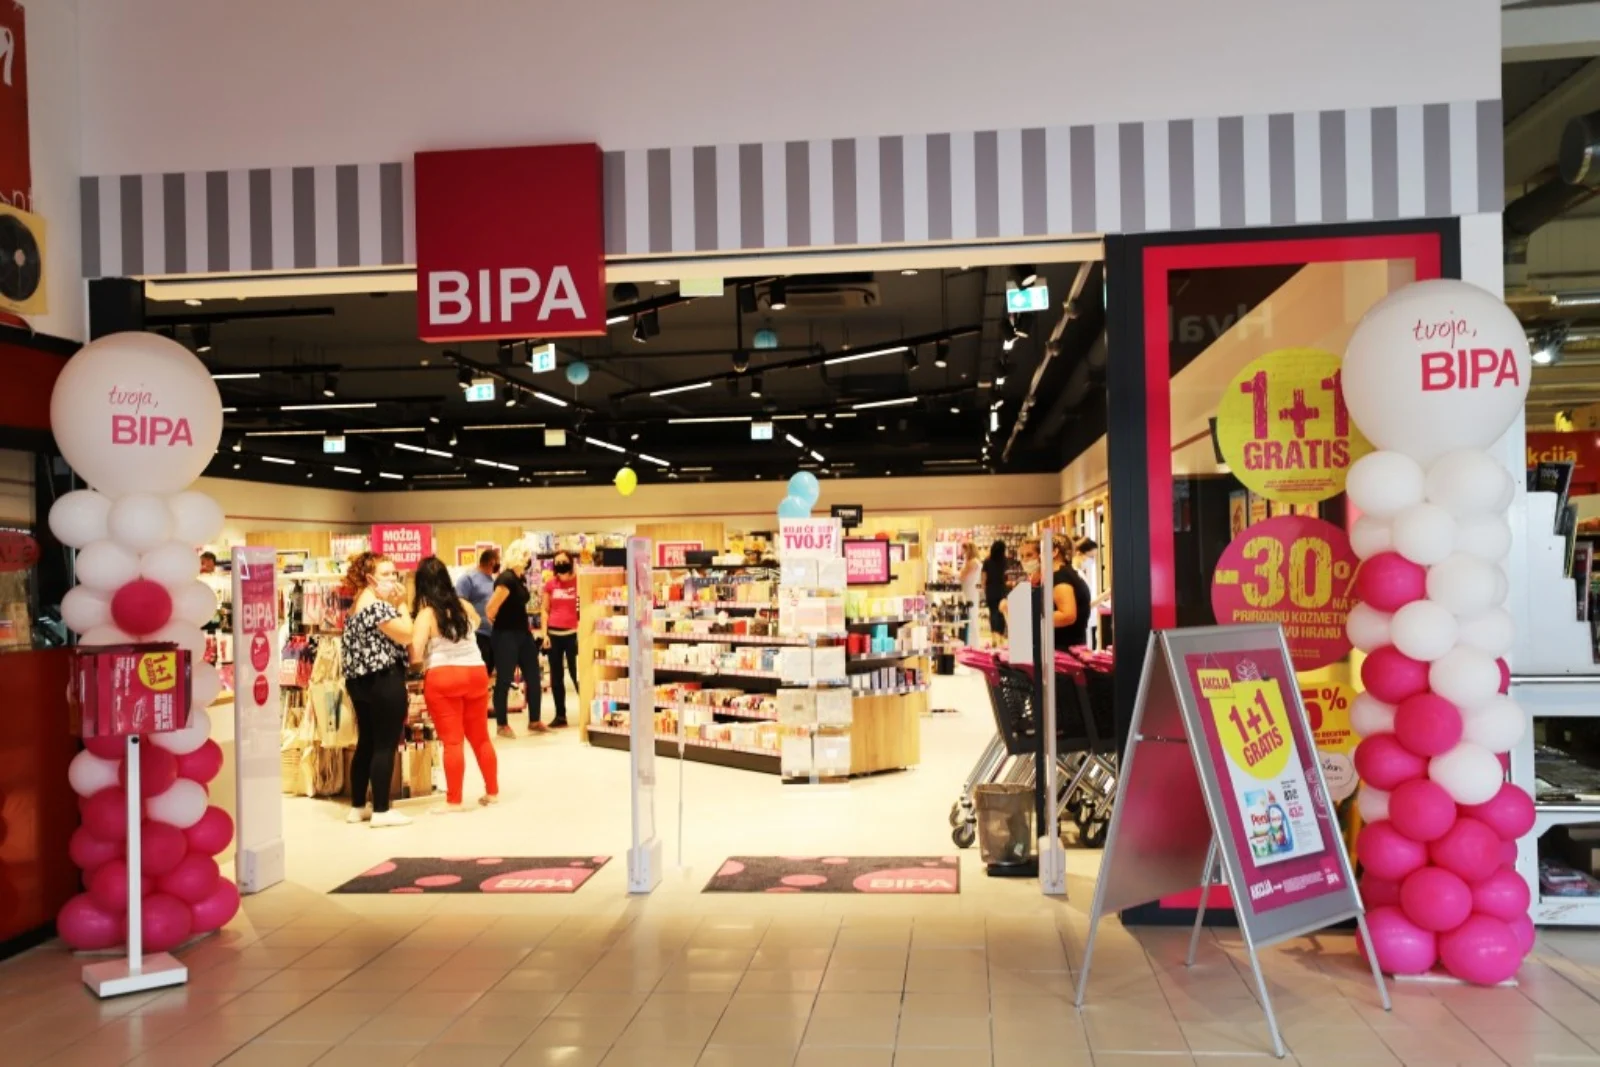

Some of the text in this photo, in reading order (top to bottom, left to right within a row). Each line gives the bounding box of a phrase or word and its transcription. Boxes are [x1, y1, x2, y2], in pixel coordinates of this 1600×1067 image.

[428, 265, 587, 326] BIPA
[1412, 310, 1478, 349] tvoja,
[1421, 348, 1520, 391] BIPA
[108, 383, 159, 415] tvoja,
[1240, 368, 1350, 439] 1+1
[112, 415, 193, 447] BIPA
[1243, 439, 1351, 470] GRATIS
[382, 528, 421, 541] MOŽDA
[783, 534, 833, 549] TVOJ?
[243, 602, 274, 629] BIPA
[1232, 609, 1349, 625] PRIRODNU KOZMETIK
[1332, 597, 1348, 610] NA
[1284, 625, 1341, 639] VU HRANU
[1228, 687, 1275, 744] 1+1
[1301, 686, 1348, 731] 5%
[1242, 726, 1284, 767] GRATIS
[869, 878, 954, 889] BIPA
